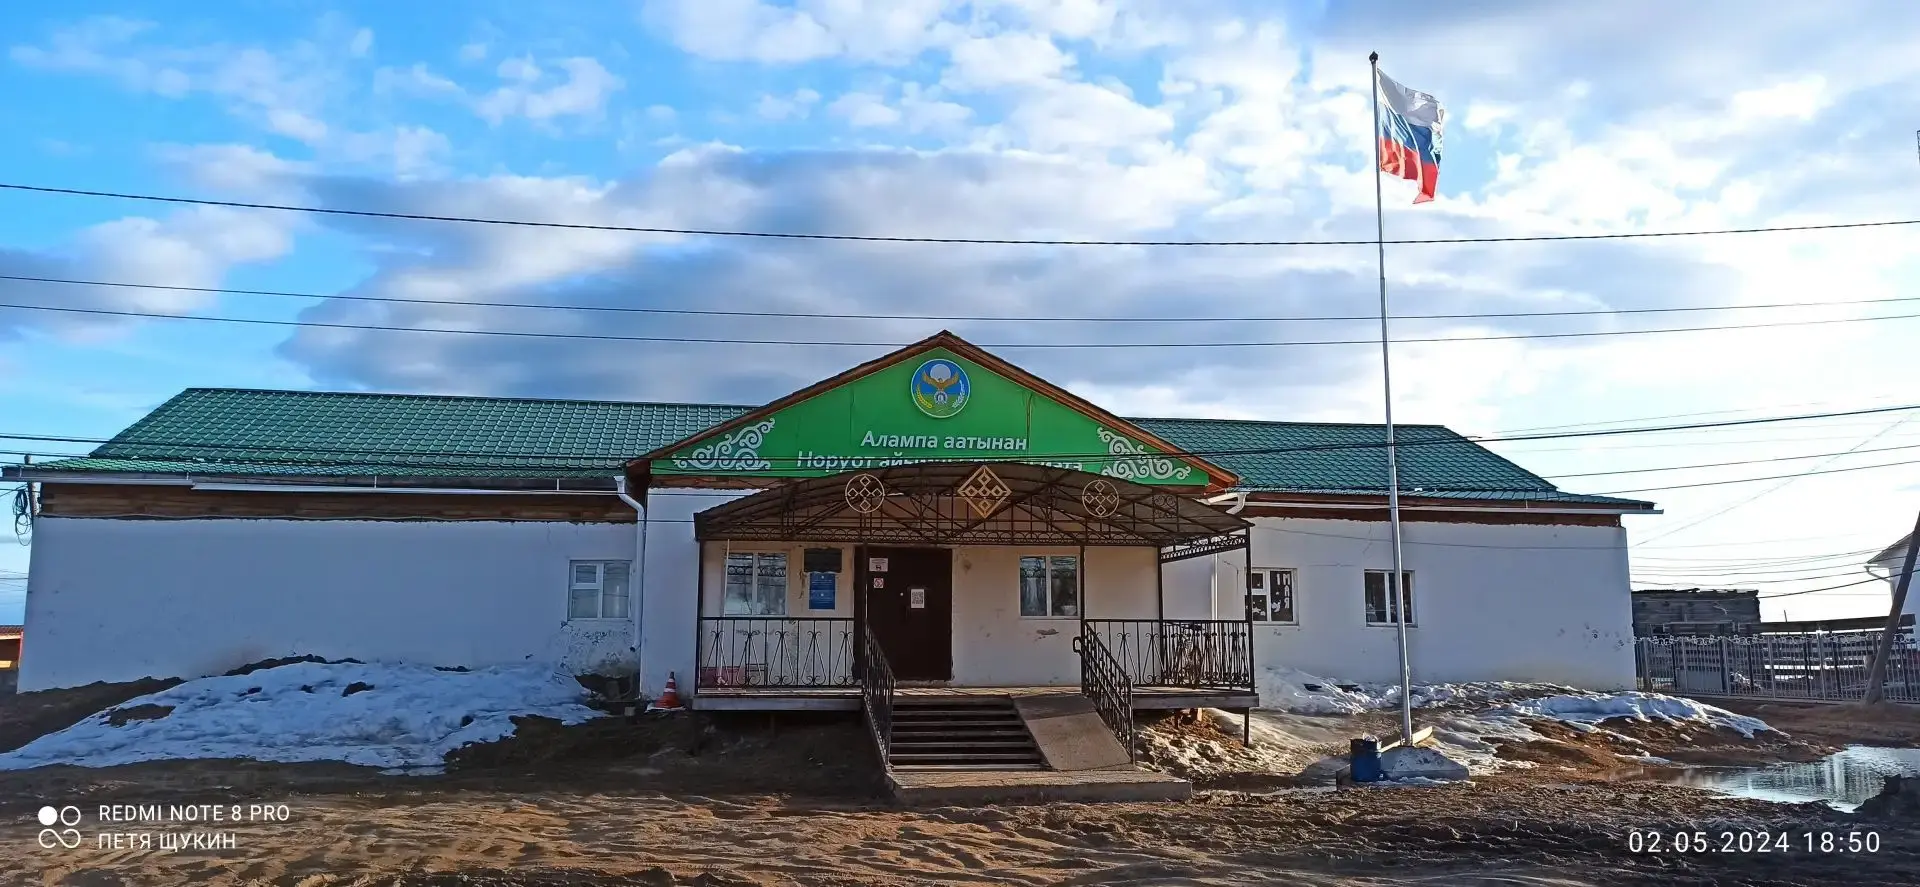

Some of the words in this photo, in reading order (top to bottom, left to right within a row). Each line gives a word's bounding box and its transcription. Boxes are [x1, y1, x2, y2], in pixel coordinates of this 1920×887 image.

[860, 430, 938, 449] Алампа
[943, 436, 1027, 451] аатынан
[796, 450, 875, 473] Норуот
